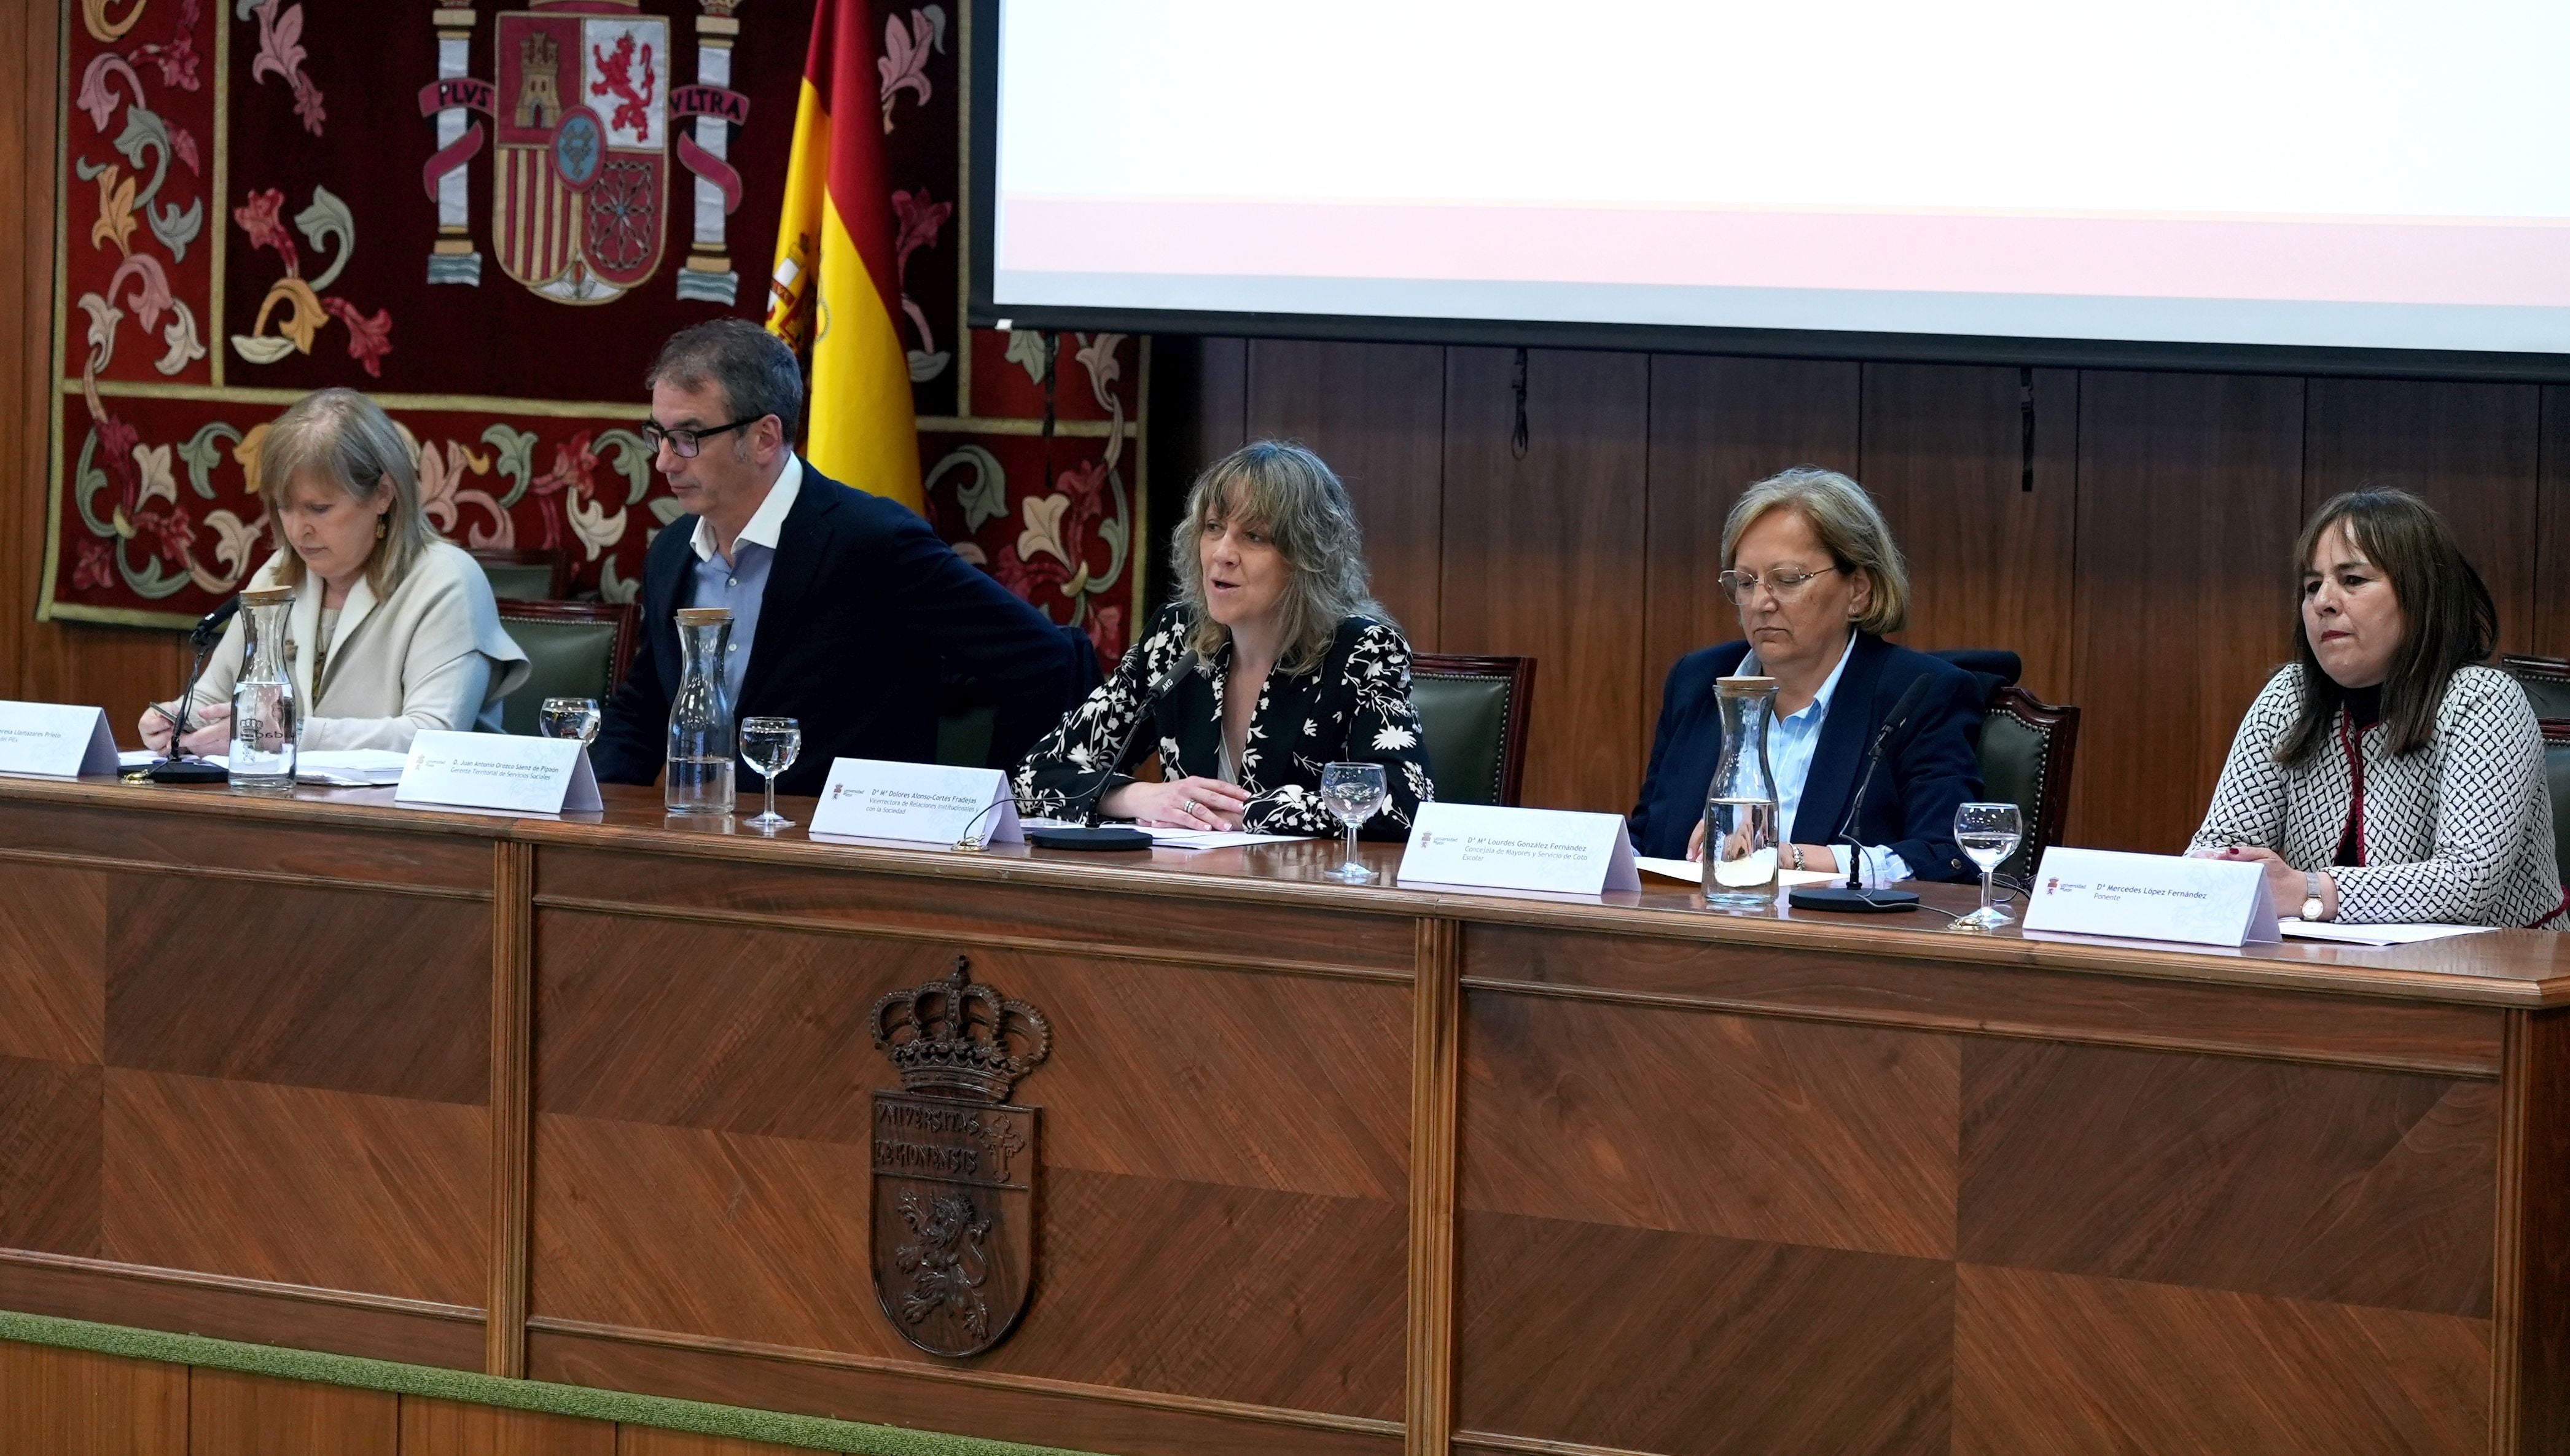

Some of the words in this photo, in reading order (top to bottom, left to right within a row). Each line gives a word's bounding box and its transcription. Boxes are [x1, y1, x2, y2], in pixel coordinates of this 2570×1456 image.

[439, 82, 491, 107] PLVS
[869, 797, 900, 806] Vicerrectora
[909, 801, 937, 809] Relaciones
[937, 803, 975, 812] Institucionales
[911, 792, 951, 802] Alonso-Cortés
[951, 795, 977, 804] Fradejas
[1488, 838, 1515, 847] Lourdes
[1517, 840, 1548, 849] González
[1550, 843, 1587, 852] Fernández
[1464, 846, 1494, 854] Concejala
[1537, 851, 1562, 859] Servicio
[2106, 884, 2141, 894] Mercedes
[2143, 887, 2166, 897] López
[2167, 889, 2208, 900] Fernández
